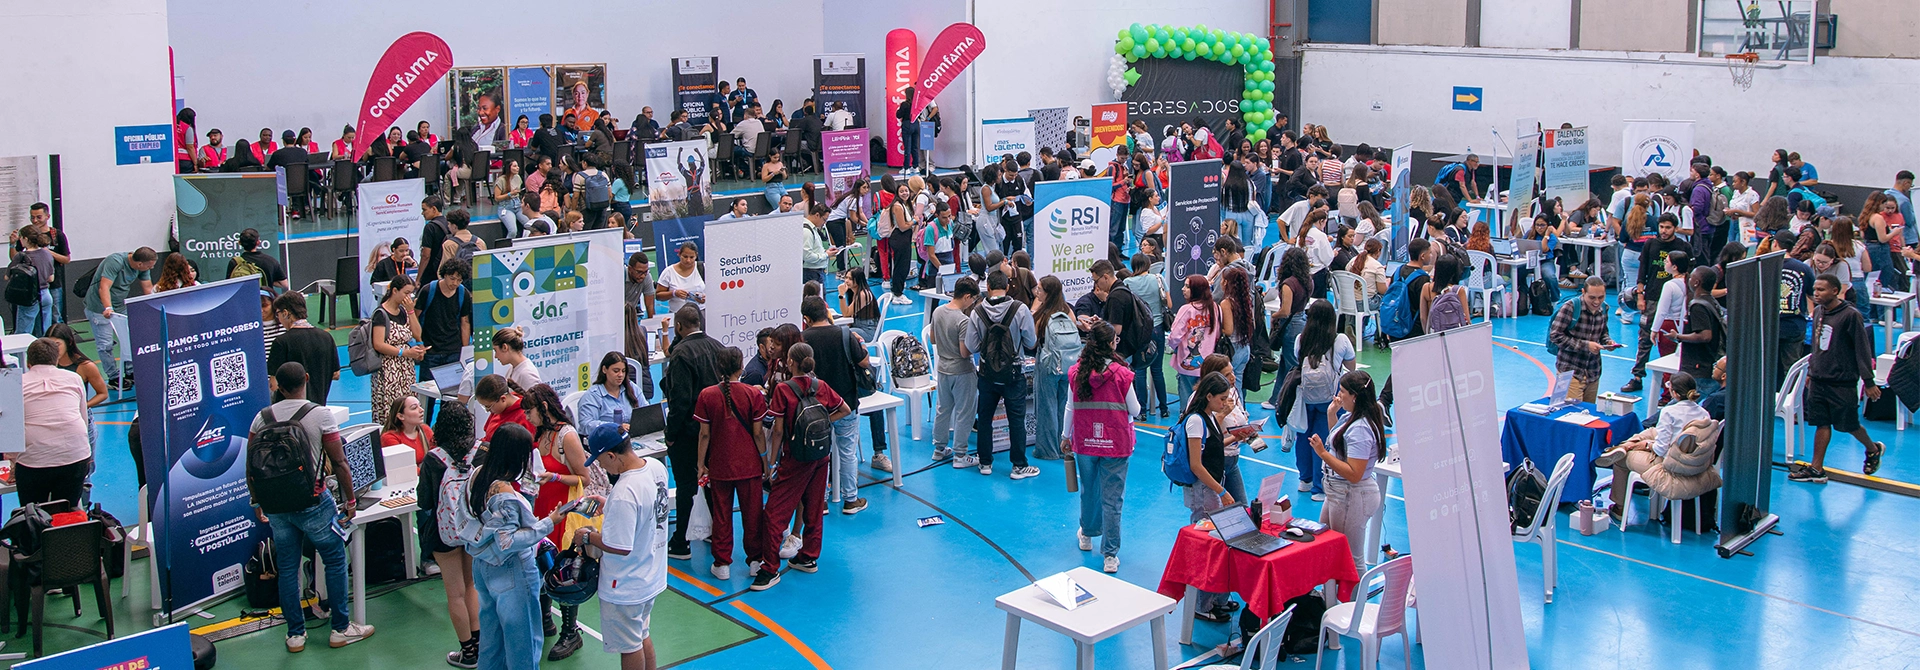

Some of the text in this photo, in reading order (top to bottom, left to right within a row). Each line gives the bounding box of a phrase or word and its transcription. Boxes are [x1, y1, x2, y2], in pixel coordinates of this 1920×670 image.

[1128, 100, 1239, 115] EGRESADOS
[144, 133, 166, 141] PÚBLICA
[1557, 129, 1584, 138] TALENTOS
[994, 143, 1025, 151] talento
[1071, 206, 1099, 226] RSI
[1051, 243, 1094, 256] We are
[720, 254, 762, 266] Securitas
[1052, 257, 1094, 273] Hiring
[720, 263, 771, 277] Technology
[1062, 277, 1085, 286] KENDS
[532, 301, 568, 320] dar
[721, 307, 789, 328] The future
[137, 321, 260, 356] ACELRAMOS TU PROGRESO
[220, 336, 233, 344] PAÍS
[722, 331, 735, 345] of
[542, 345, 579, 358] interesa
[545, 354, 570, 368] perfil
[222, 400, 244, 408] LABORALES
[173, 409, 192, 417] VACANTES
[194, 504, 212, 514] nuestro
[213, 499, 228, 507] motor
[236, 490, 250, 499] cambi
[196, 490, 227, 506] INNOVACIÓN
[233, 484, 248, 492] PASIÓ
[200, 524, 220, 535] Ingresa
[225, 515, 244, 525] nuestro
[198, 532, 219, 543] PORTAL
[228, 522, 249, 532] EMPLEO
[206, 531, 249, 552] POSTÚLATE
[218, 574, 240, 588] talento
[128, 659, 145, 670] DE
